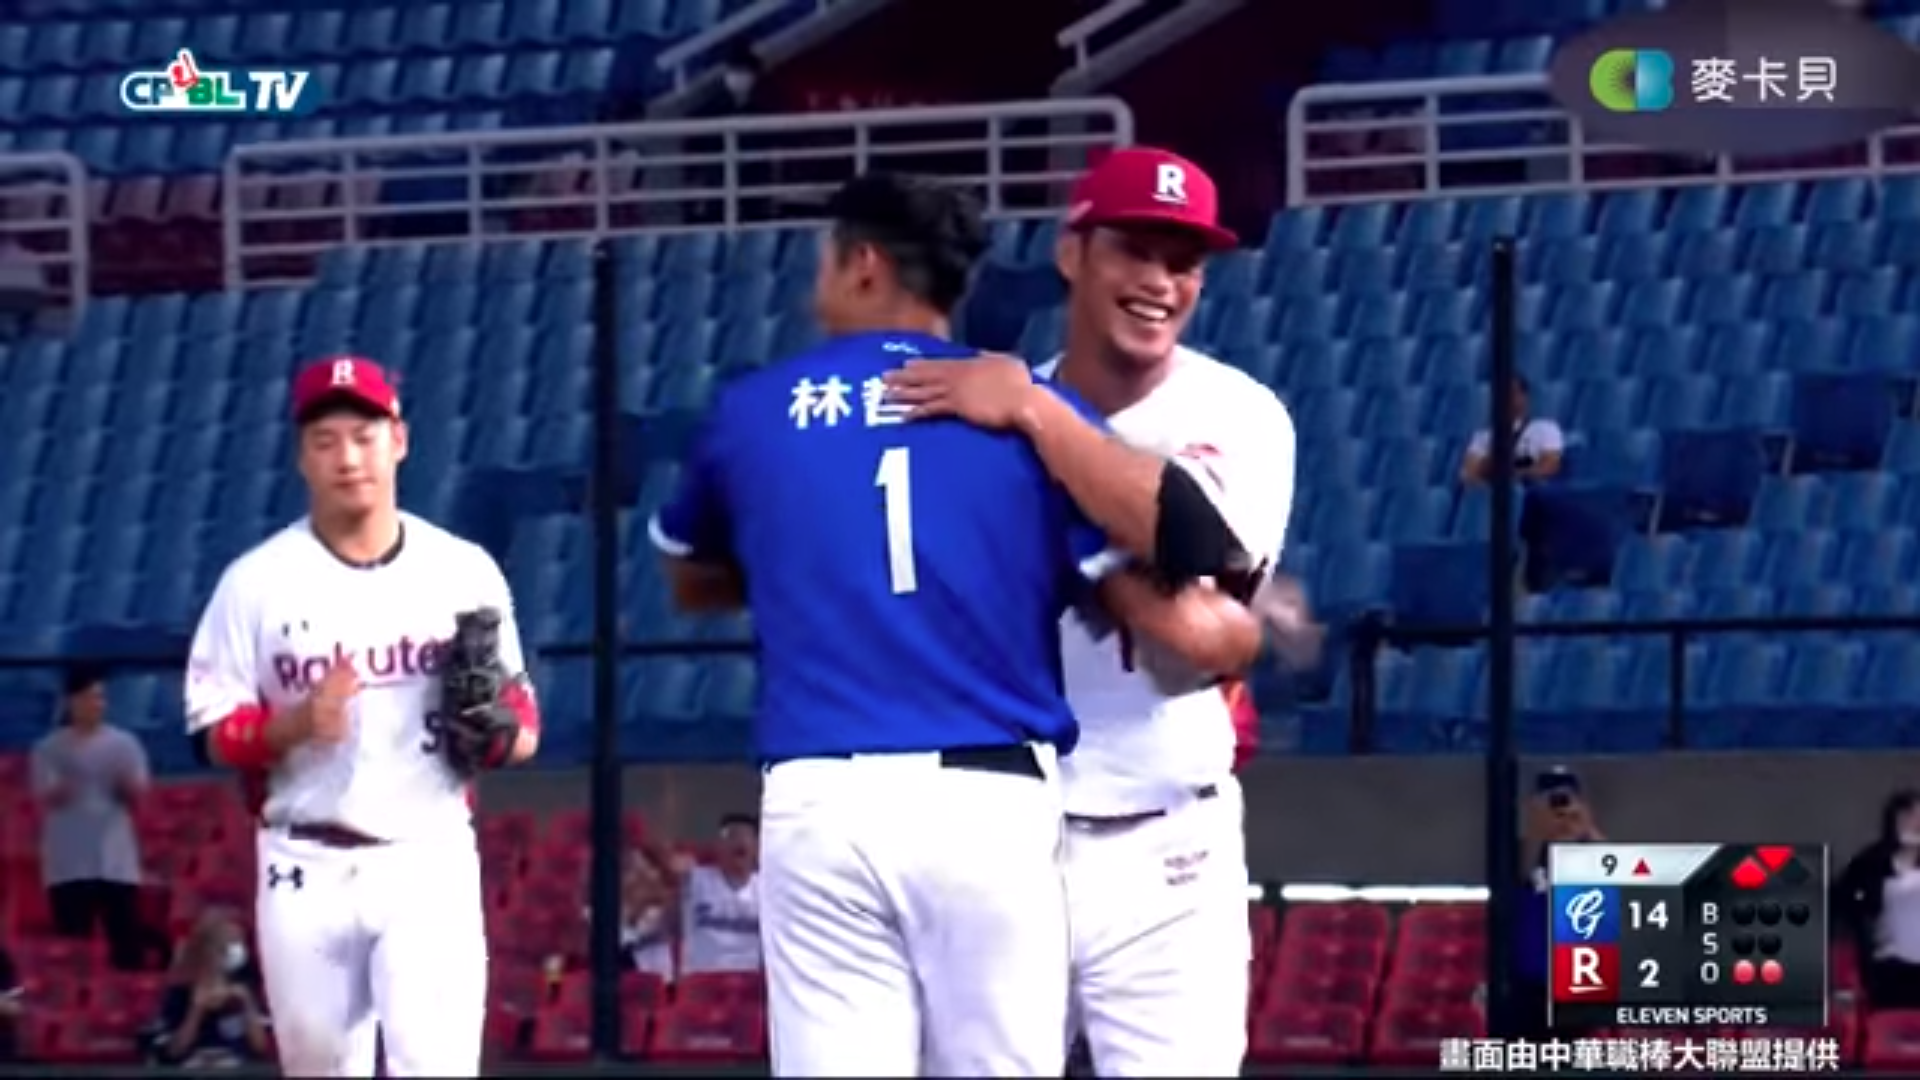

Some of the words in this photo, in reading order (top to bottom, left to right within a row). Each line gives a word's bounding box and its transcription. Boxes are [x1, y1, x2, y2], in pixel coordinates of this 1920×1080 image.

[1152, 164, 1189, 204] R
[332, 359, 356, 386] R
[875, 446, 917, 594] 1
